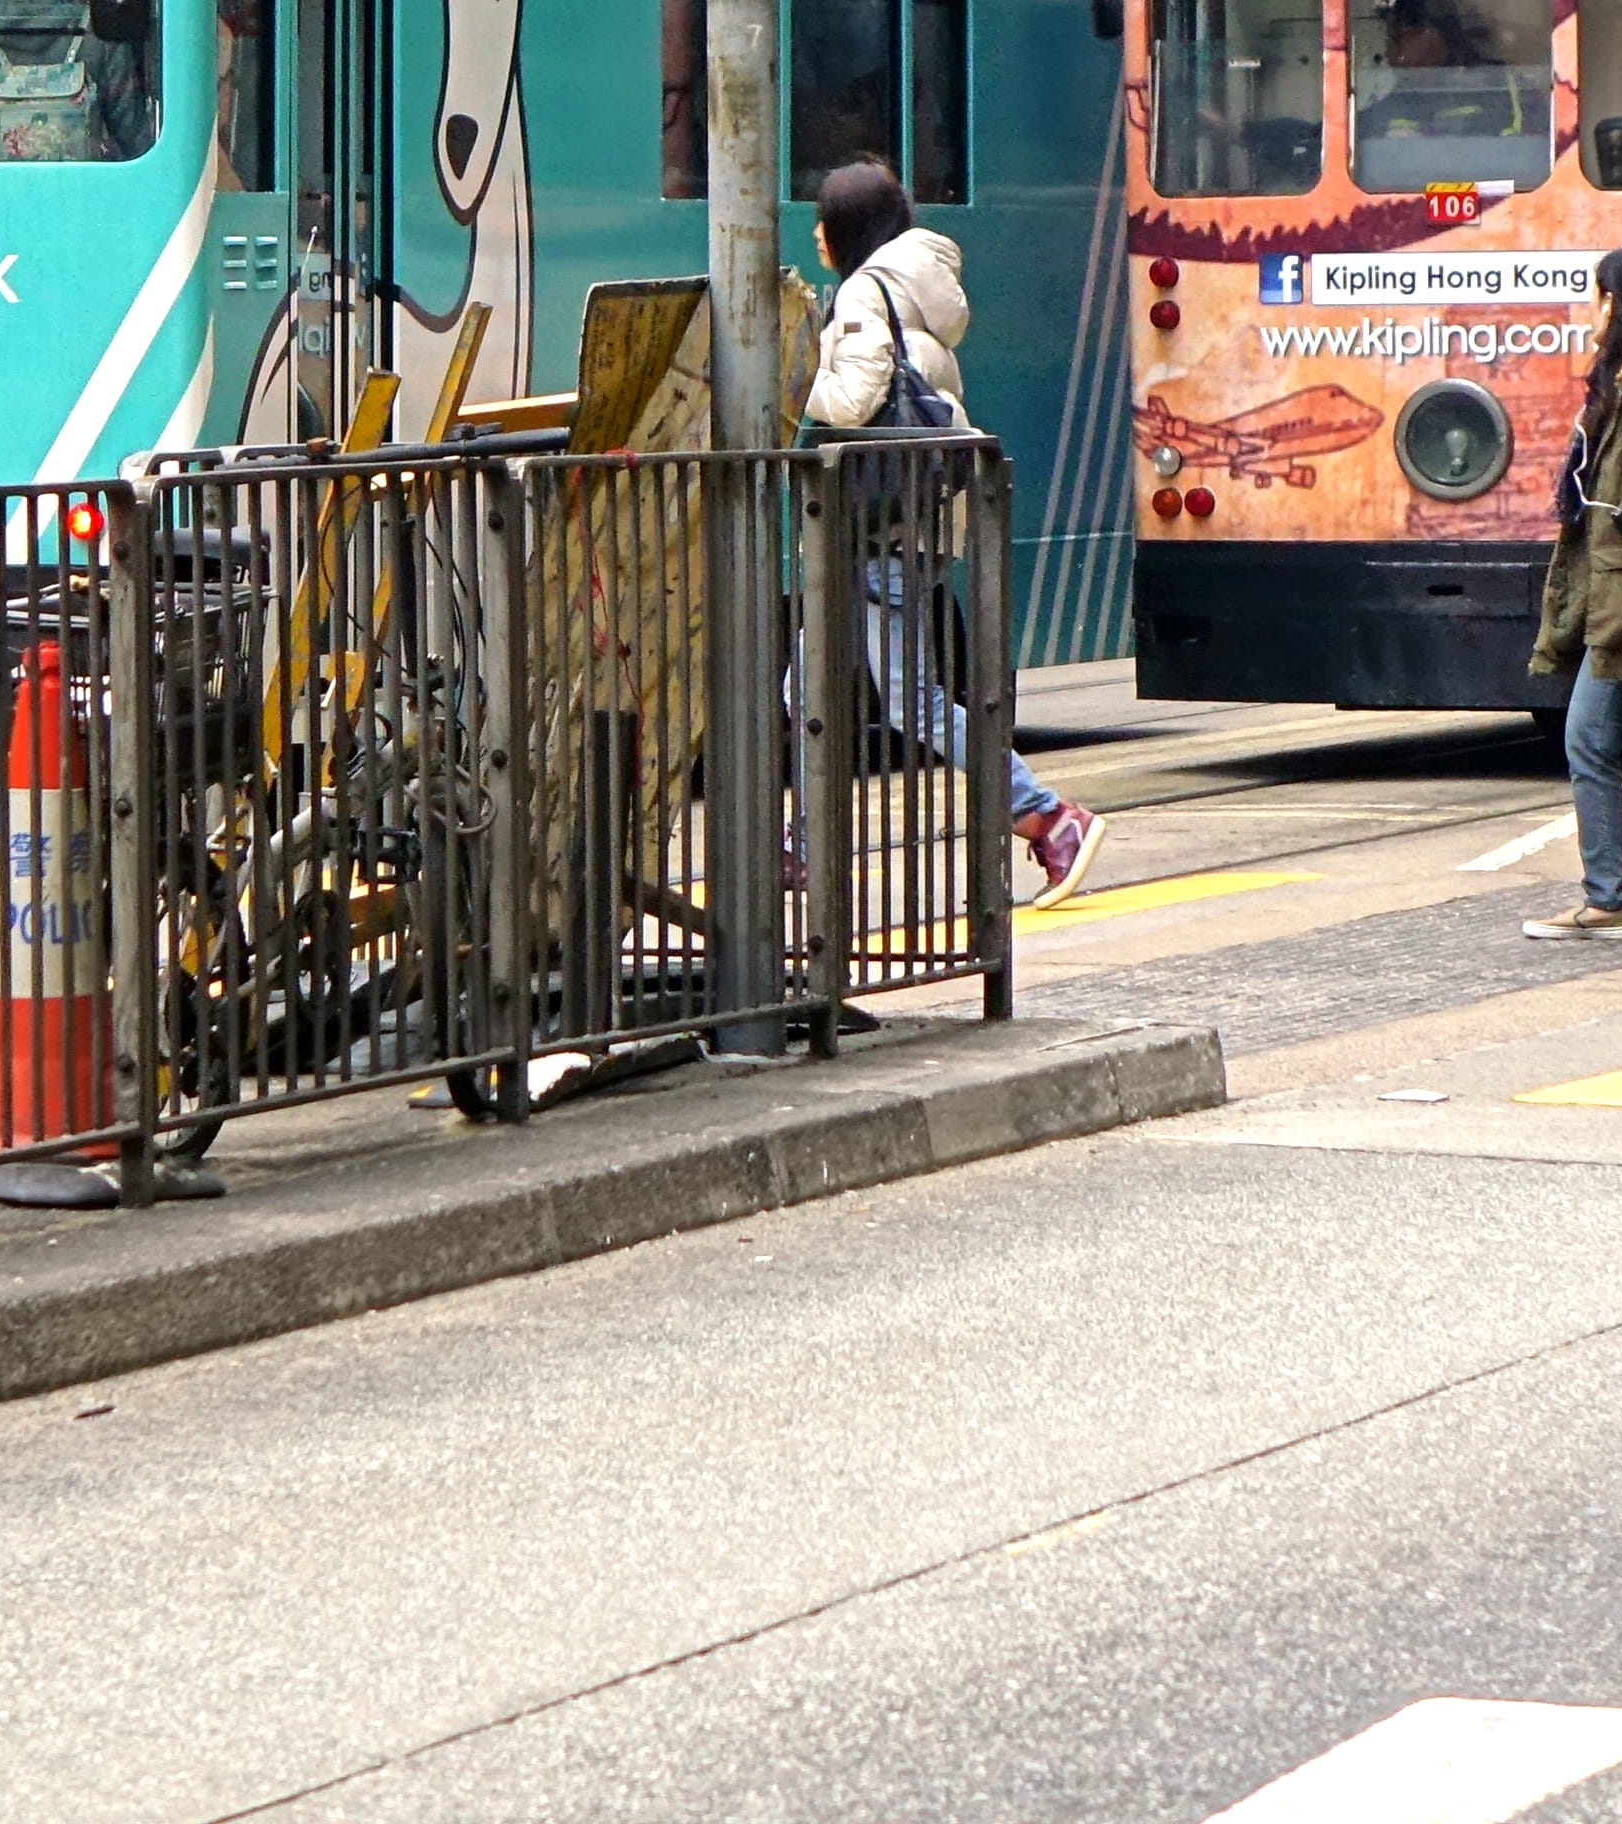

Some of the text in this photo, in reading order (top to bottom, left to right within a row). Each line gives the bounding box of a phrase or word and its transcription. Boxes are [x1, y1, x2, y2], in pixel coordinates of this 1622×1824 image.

[1429, 194, 1476, 221] 106
[1325, 265, 1417, 295] Kipling
[1428, 264, 1502, 293] Hong
[1513, 263, 1588, 293] Kong
